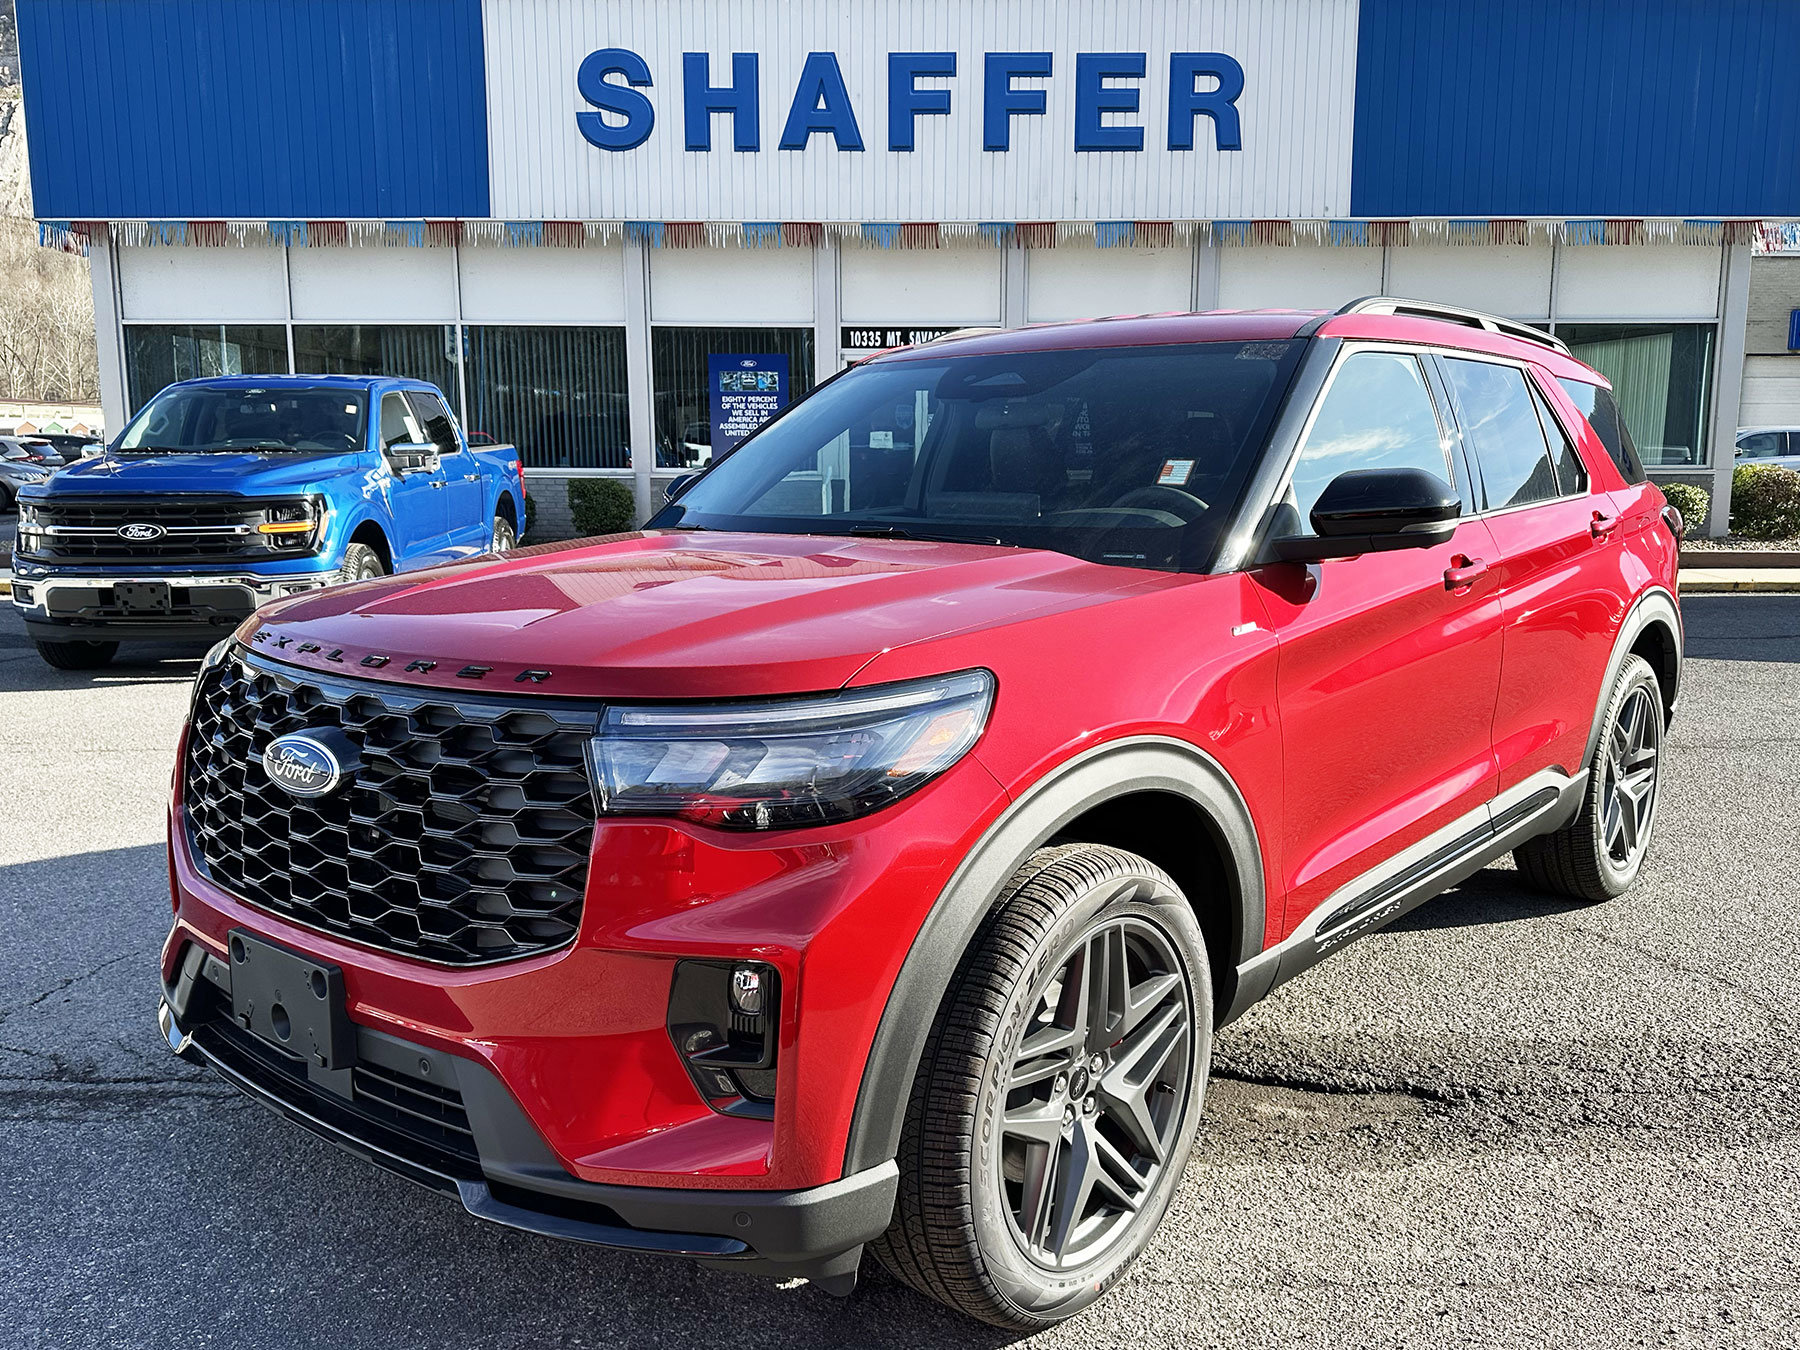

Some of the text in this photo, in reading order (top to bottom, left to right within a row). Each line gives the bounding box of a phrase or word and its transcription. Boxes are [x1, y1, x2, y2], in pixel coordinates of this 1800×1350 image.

[575, 47, 1245, 152] SHAFFER
[850, 330, 946, 346] 10335 MT. SAVA
[251, 629, 554, 684] EXPLORER
[979, 1001, 1021, 1189] SCORPION
[1026, 918, 1075, 997] ZERO
